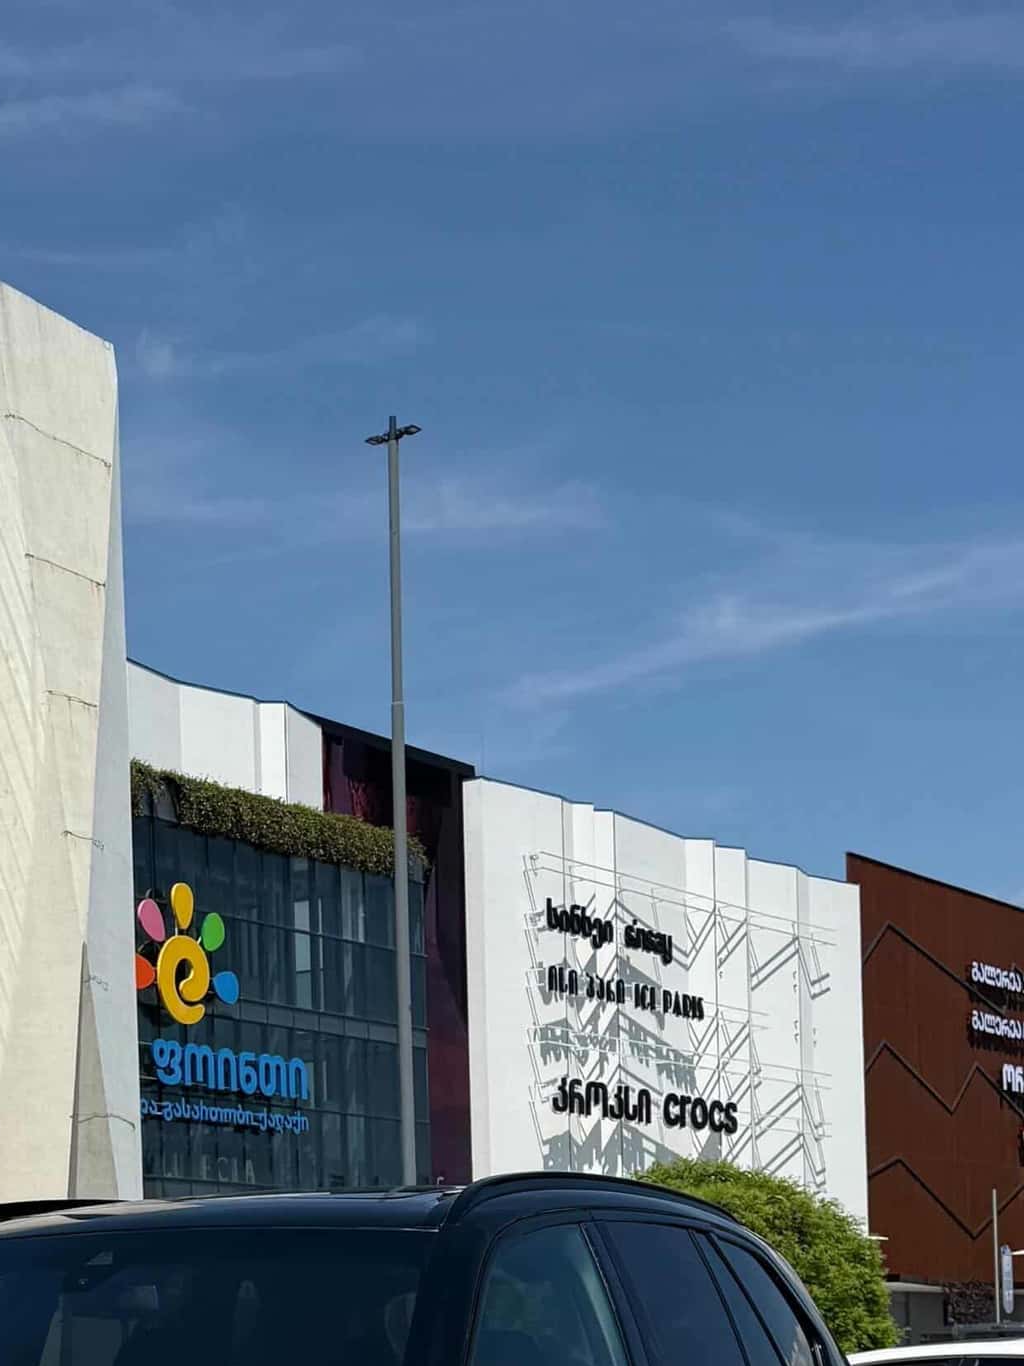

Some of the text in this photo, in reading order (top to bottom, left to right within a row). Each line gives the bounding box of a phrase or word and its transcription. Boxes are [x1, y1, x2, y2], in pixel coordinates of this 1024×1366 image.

[634, 983, 656, 1012] ICI
[662, 989, 705, 1021] PARIS
[152, 1039, 308, 1100] ფოინთი
